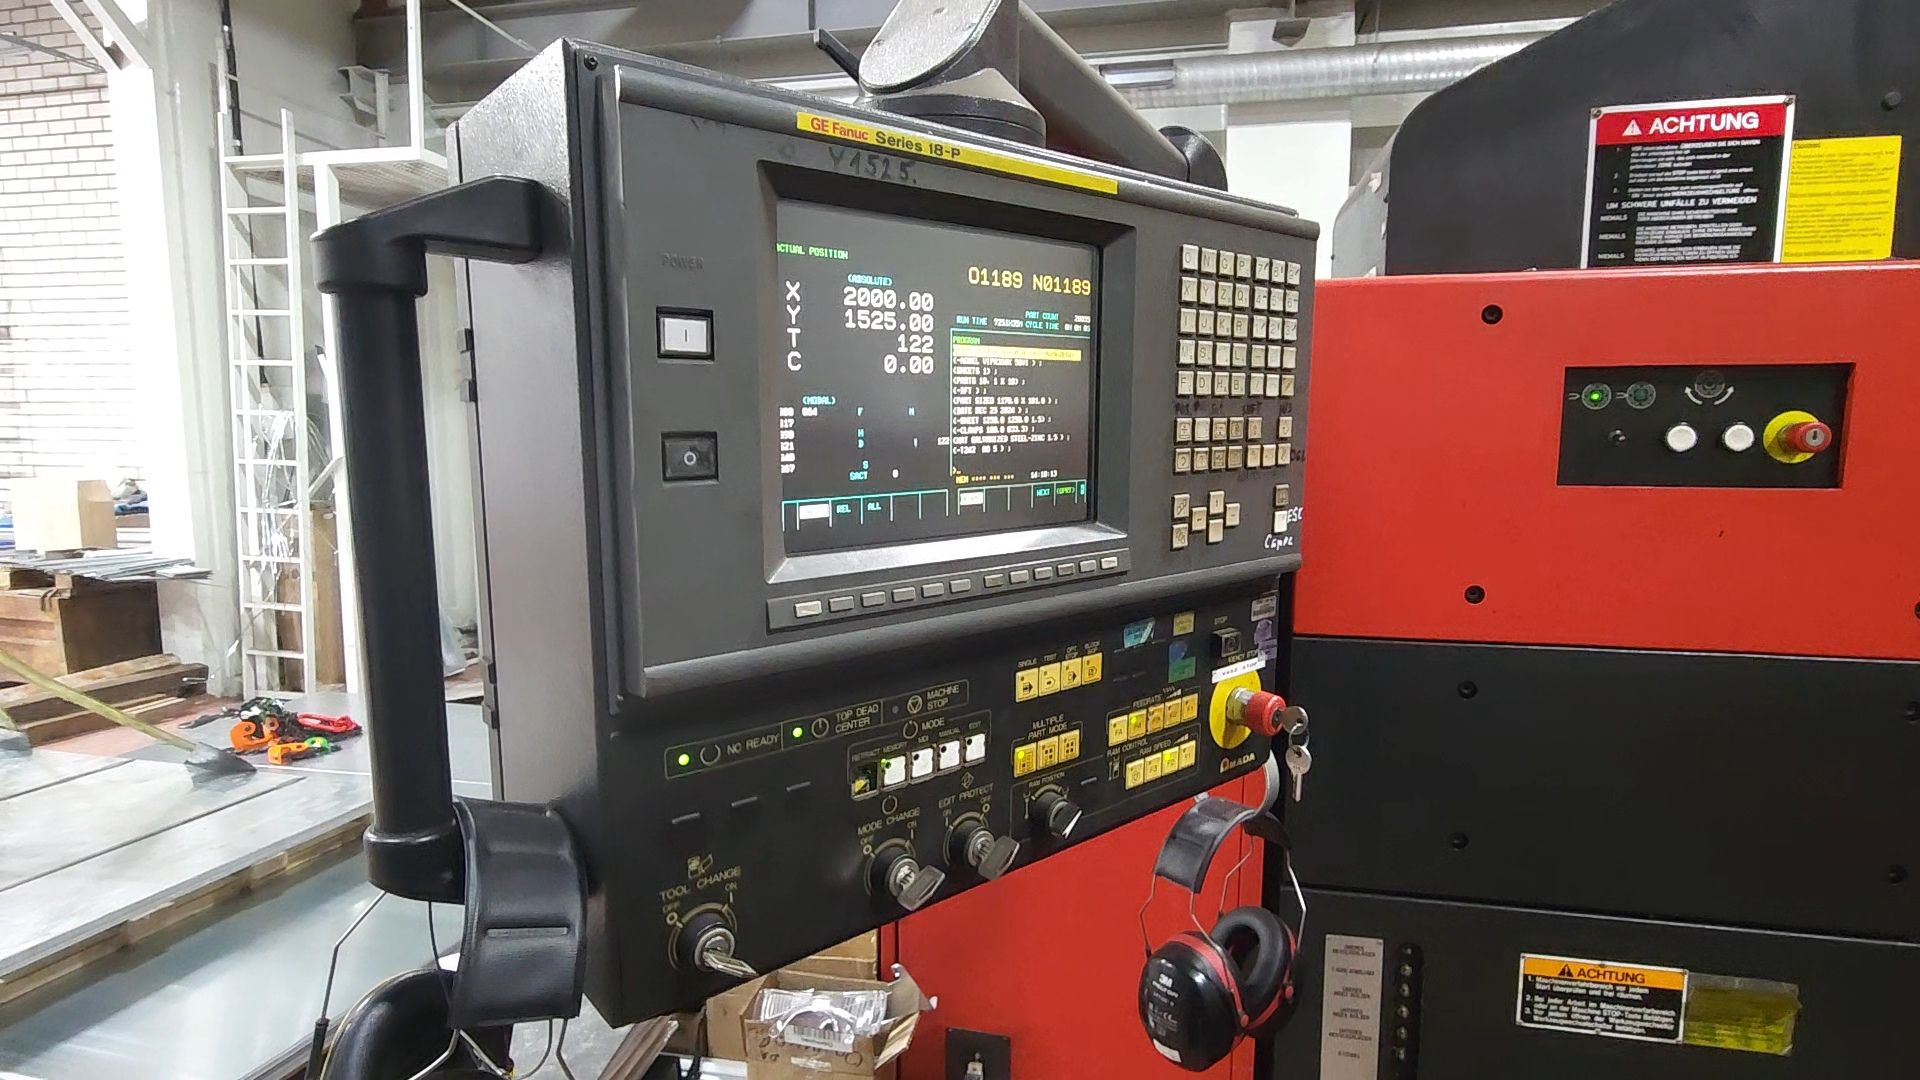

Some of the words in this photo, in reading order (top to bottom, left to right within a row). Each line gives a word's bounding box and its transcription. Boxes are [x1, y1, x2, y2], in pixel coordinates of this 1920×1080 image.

[1649, 112, 1760, 135] ACHTUNG
[811, 117, 829, 132] GE
[832, 122, 869, 140] Fanuc
[876, 131, 922, 152] Series
[929, 143, 960, 158] 18-P
[1621, 200, 1658, 208] SCHWERE
[809, 246, 848, 260] POSITION
[786, 280, 800, 302] X
[843, 286, 934, 312] 2000.00
[786, 304, 800, 324] Y
[844, 308, 934, 332] 1525.00
[956, 315, 970, 324] RUN
[972, 316, 988, 326] TIME
[1025, 311, 1040, 320] PART
[1042, 312, 1059, 320] COUNT
[1025, 321, 1043, 330] CYCLE
[1046, 322, 1059, 331] TIME
[786, 328, 800, 348] T
[898, 334, 934, 354] 122
[787, 351, 802, 371] C
[884, 354, 934, 374] 0.00
[802, 396, 836, 405] (MODAL)
[863, 460, 868, 469] S
[850, 472, 868, 480] SACT
[836, 504, 851, 513] REL
[868, 502, 882, 511] ALL
[1214, 616, 1228, 624] STOP
[927, 684, 960, 700] MACHINE
[928, 699, 948, 710] STOP
[836, 710, 852, 722] TOP
[856, 704, 879, 716] DEAD
[836, 718, 871, 733] CENTER
[922, 718, 944, 730] MODE
[1032, 714, 1064, 730] MULTIPLE
[1028, 728, 1046, 740] PART
[1049, 722, 1068, 734] MODE
[727, 742, 742, 755] NO
[746, 734, 780, 749] READY
[1153, 740, 1172, 752] SPEED
[938, 796, 955, 808] EDIT
[958, 783, 994, 800] PROTECT
[858, 820, 882, 835] MODE
[886, 807, 920, 825] CHANGE
[660, 885, 690, 902] TOOL
[697, 866, 742, 888] CHANGE
[725, 881, 737, 891] ON
[1577, 968, 1645, 984] ACHTUNG
